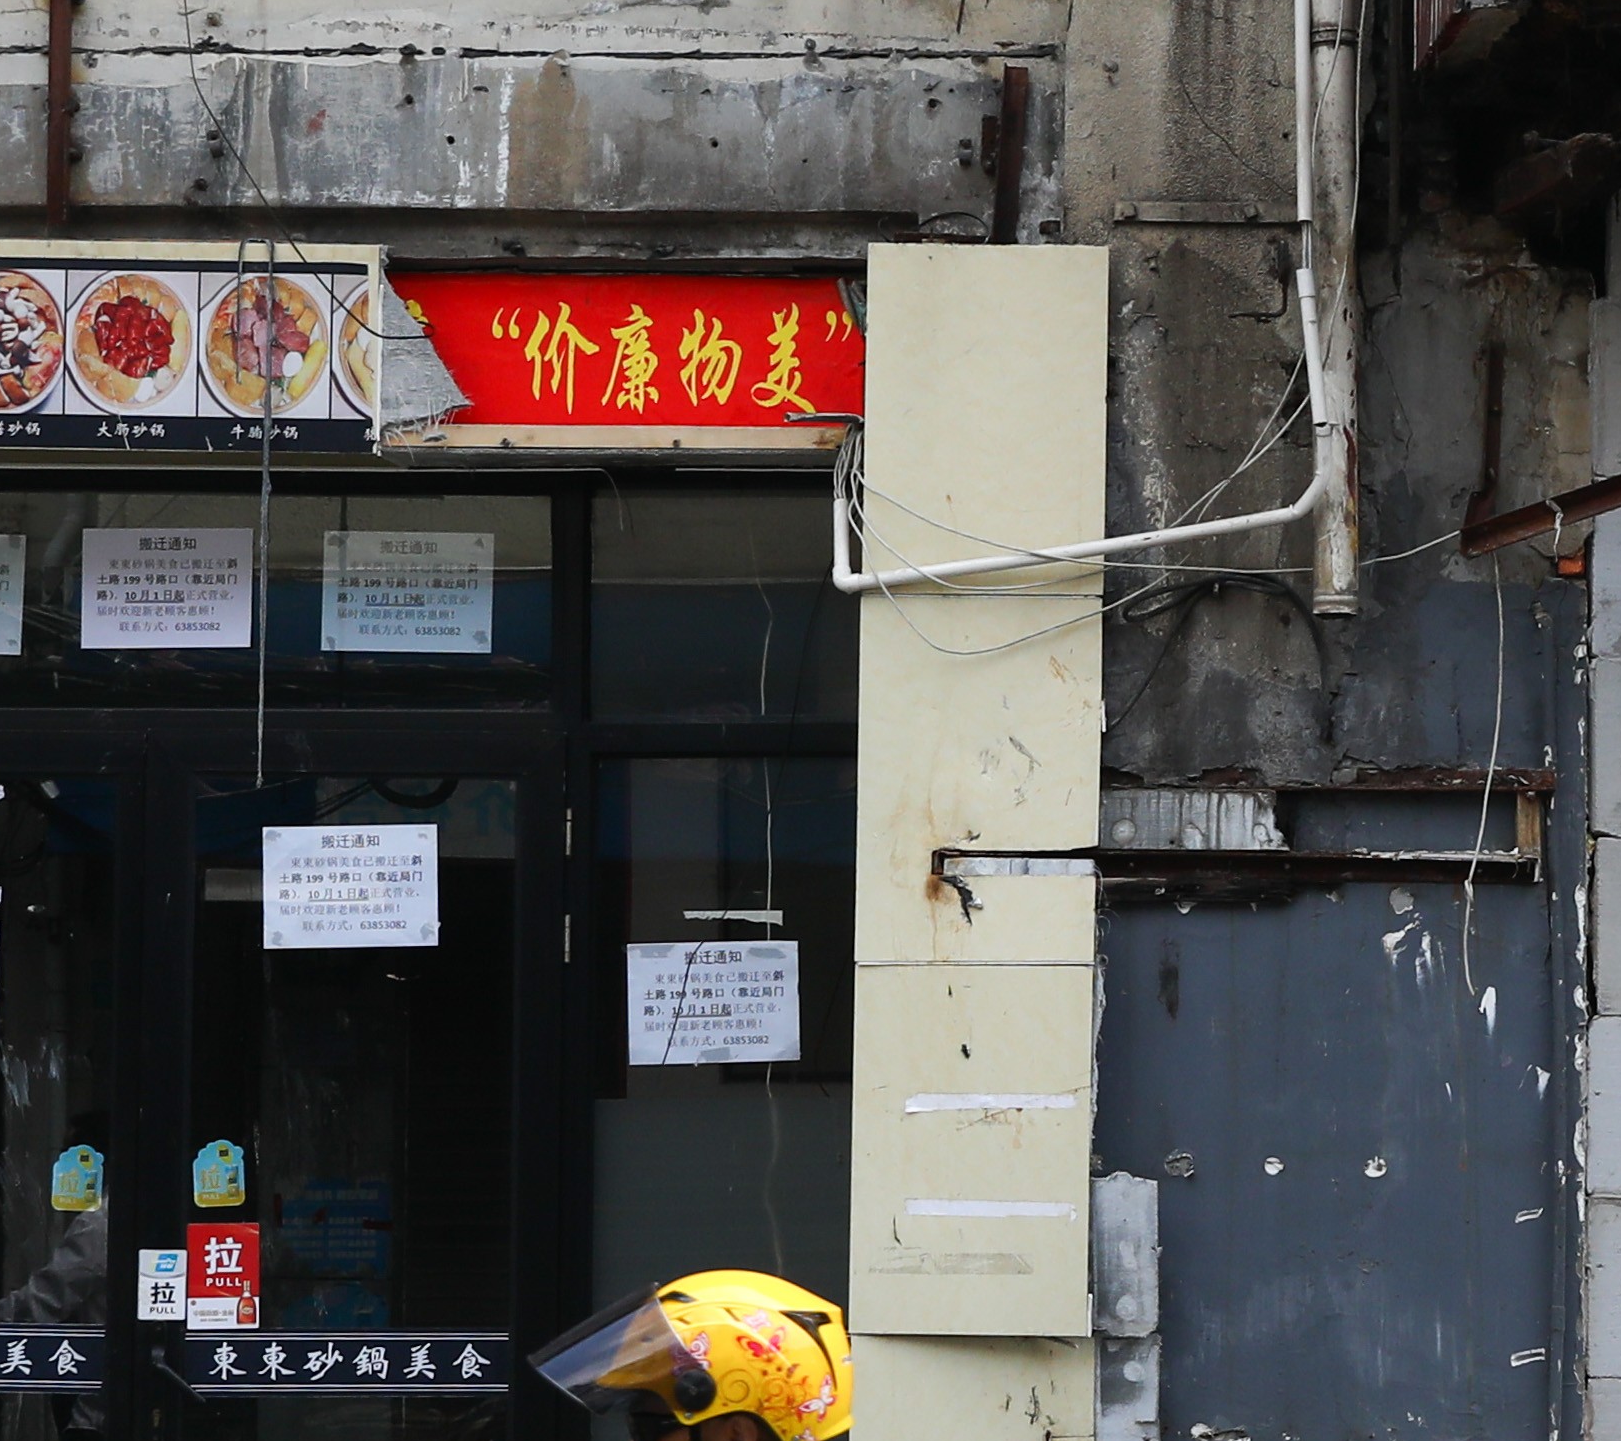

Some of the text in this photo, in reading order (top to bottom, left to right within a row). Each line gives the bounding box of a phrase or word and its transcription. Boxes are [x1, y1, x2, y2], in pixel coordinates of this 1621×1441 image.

[139, 537, 197, 550] 搬迁通知
[380, 540, 438, 555] 搬迁通知
[321, 834, 380, 849] 搬迁通知
[684, 950, 742, 965] 搬迁通知
[204, 1236, 244, 1275] 拉
[205, 1277, 242, 1287] PULL
[150, 1282, 177, 1305] 拉
[149, 1307, 177, 1315] PULL
[208, 1341, 491, 1381] 東東砂鍋美食
